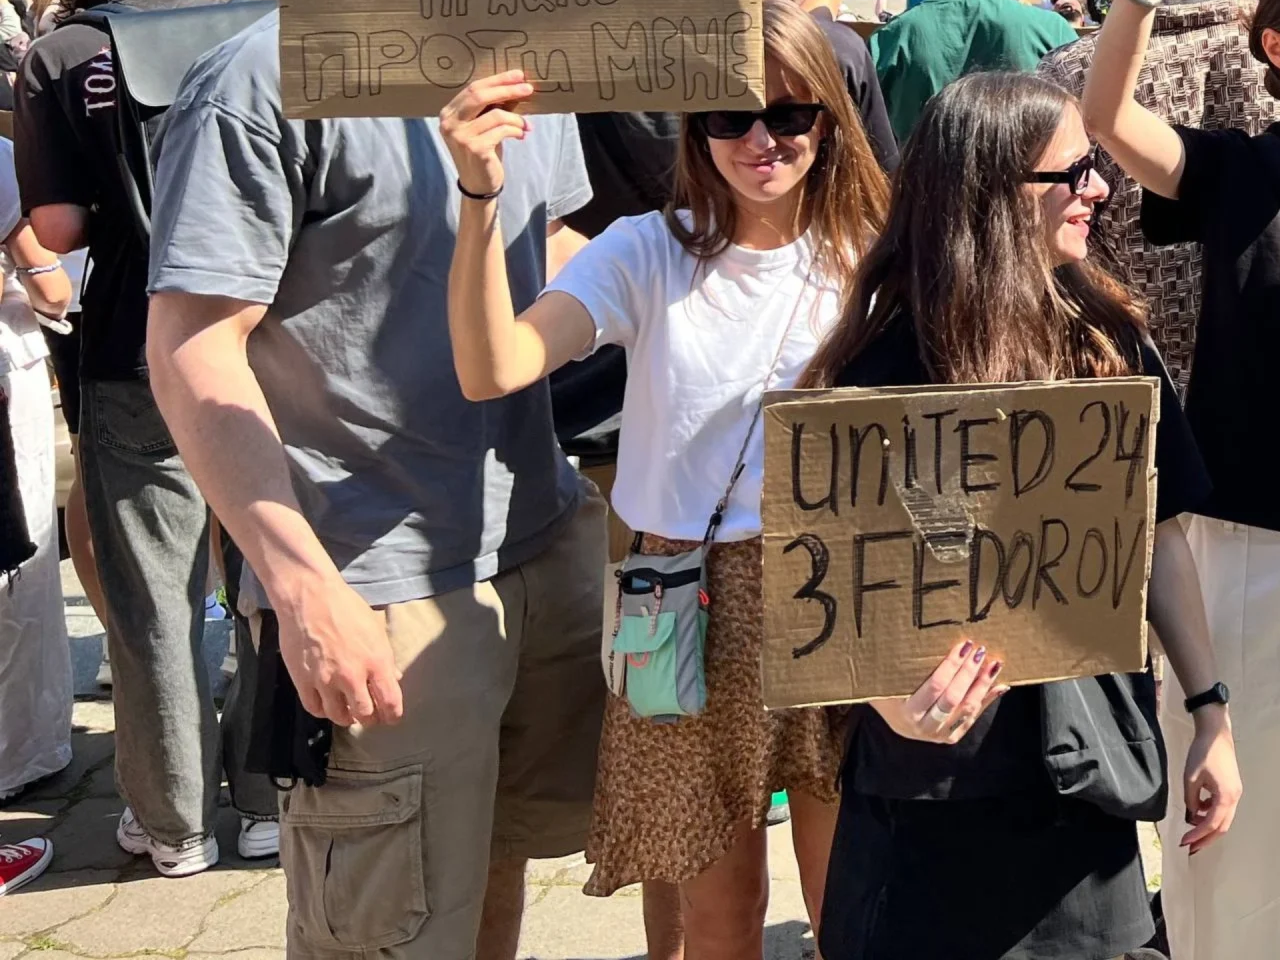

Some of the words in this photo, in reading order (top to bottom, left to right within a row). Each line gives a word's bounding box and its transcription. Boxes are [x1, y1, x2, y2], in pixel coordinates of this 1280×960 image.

[590, 11, 755, 102] МЕНЕ
[1063, 400, 1147, 509] 24
[852, 514, 1145, 639] FEDOROV
